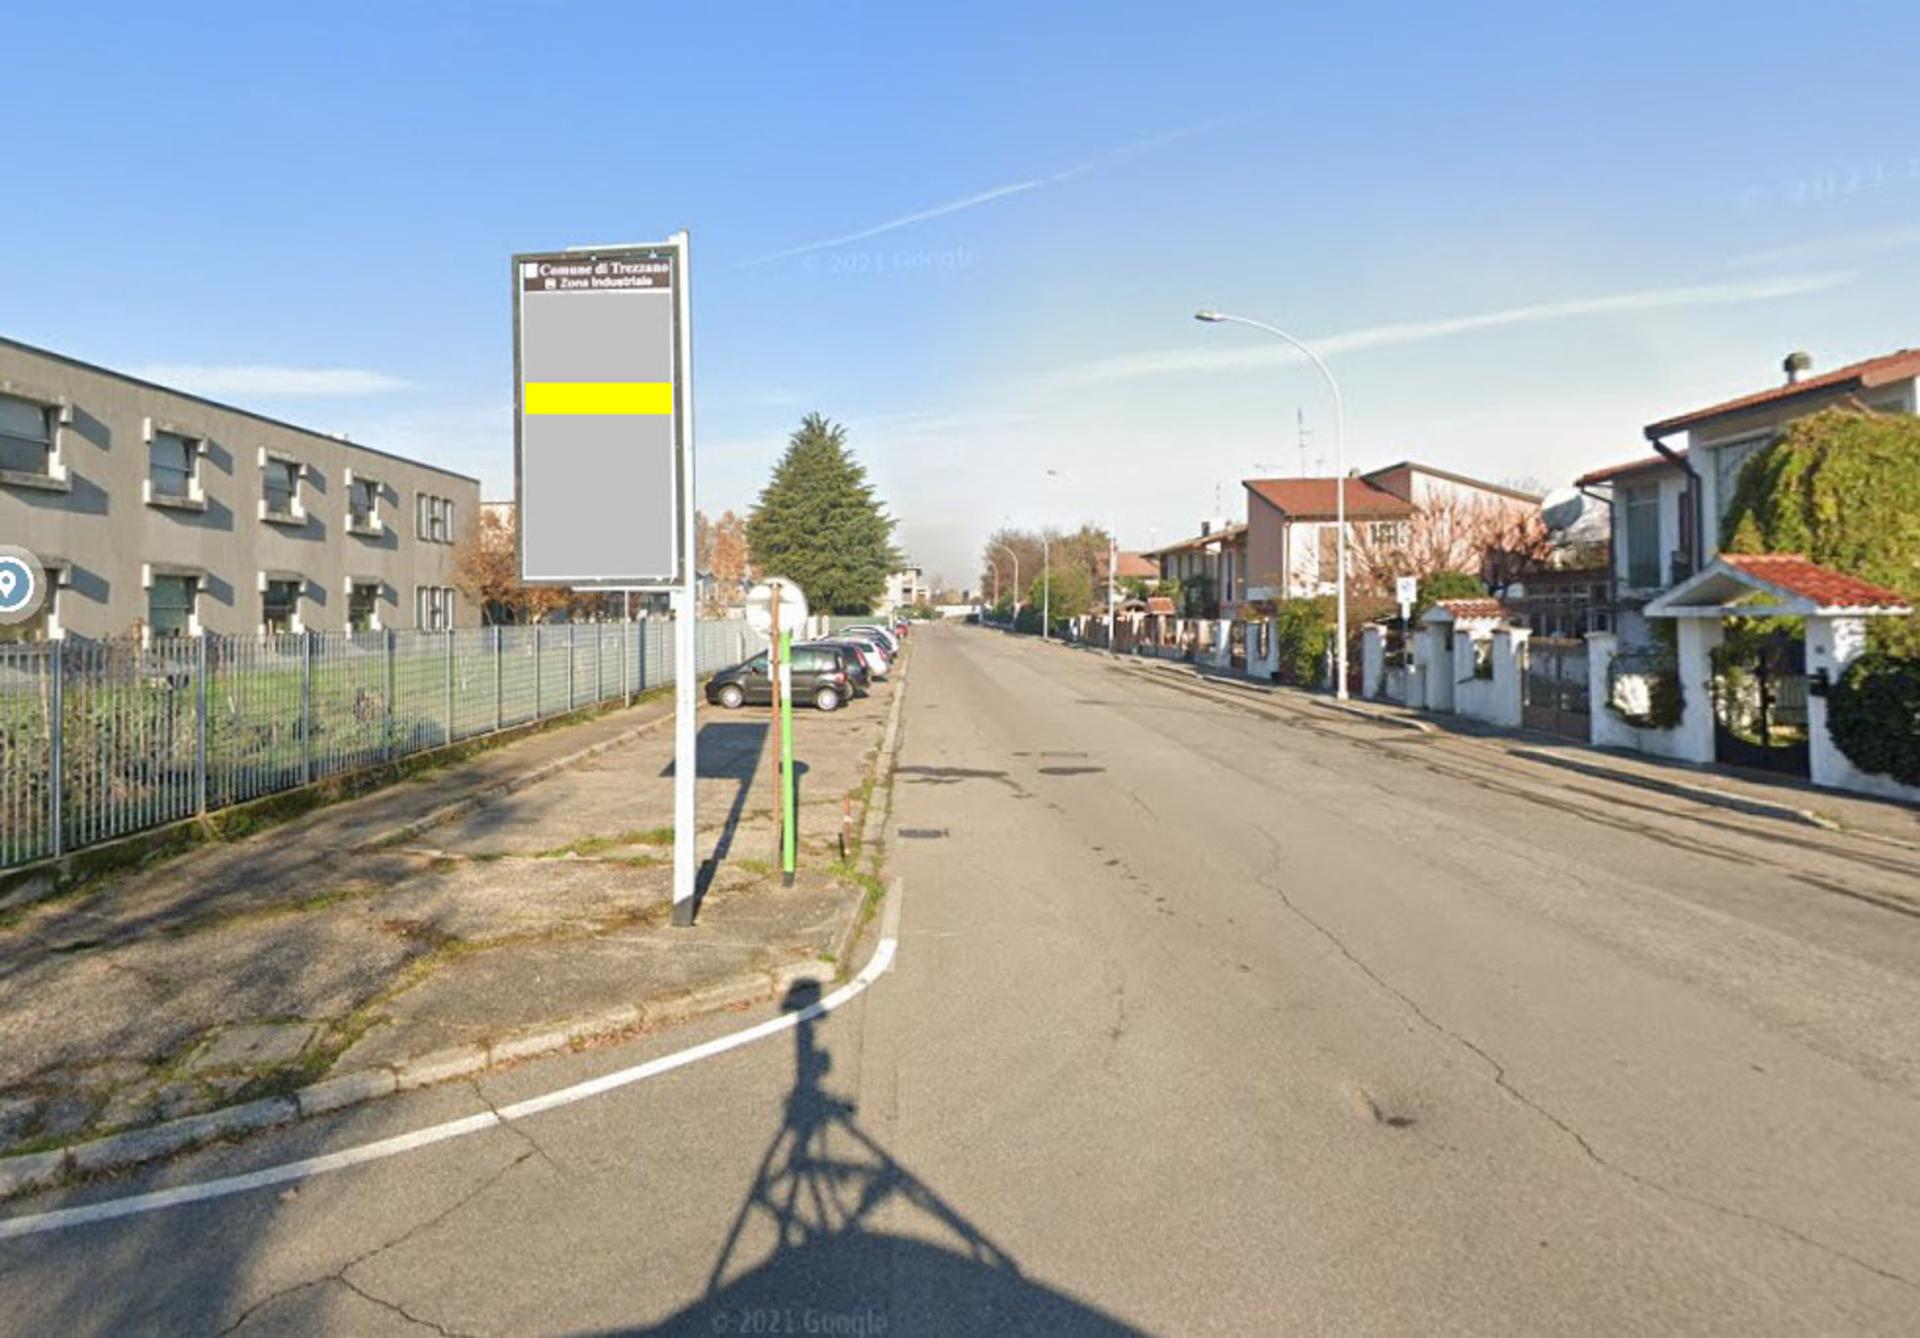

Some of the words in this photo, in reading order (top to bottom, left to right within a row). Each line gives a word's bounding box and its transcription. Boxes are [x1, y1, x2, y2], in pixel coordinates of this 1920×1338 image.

[539, 263, 592, 276] Comune
[595, 262, 608, 275] di
[610, 261, 669, 274] Trezzano
[560, 277, 589, 288] Zona
[591, 275, 653, 288] Industriale
